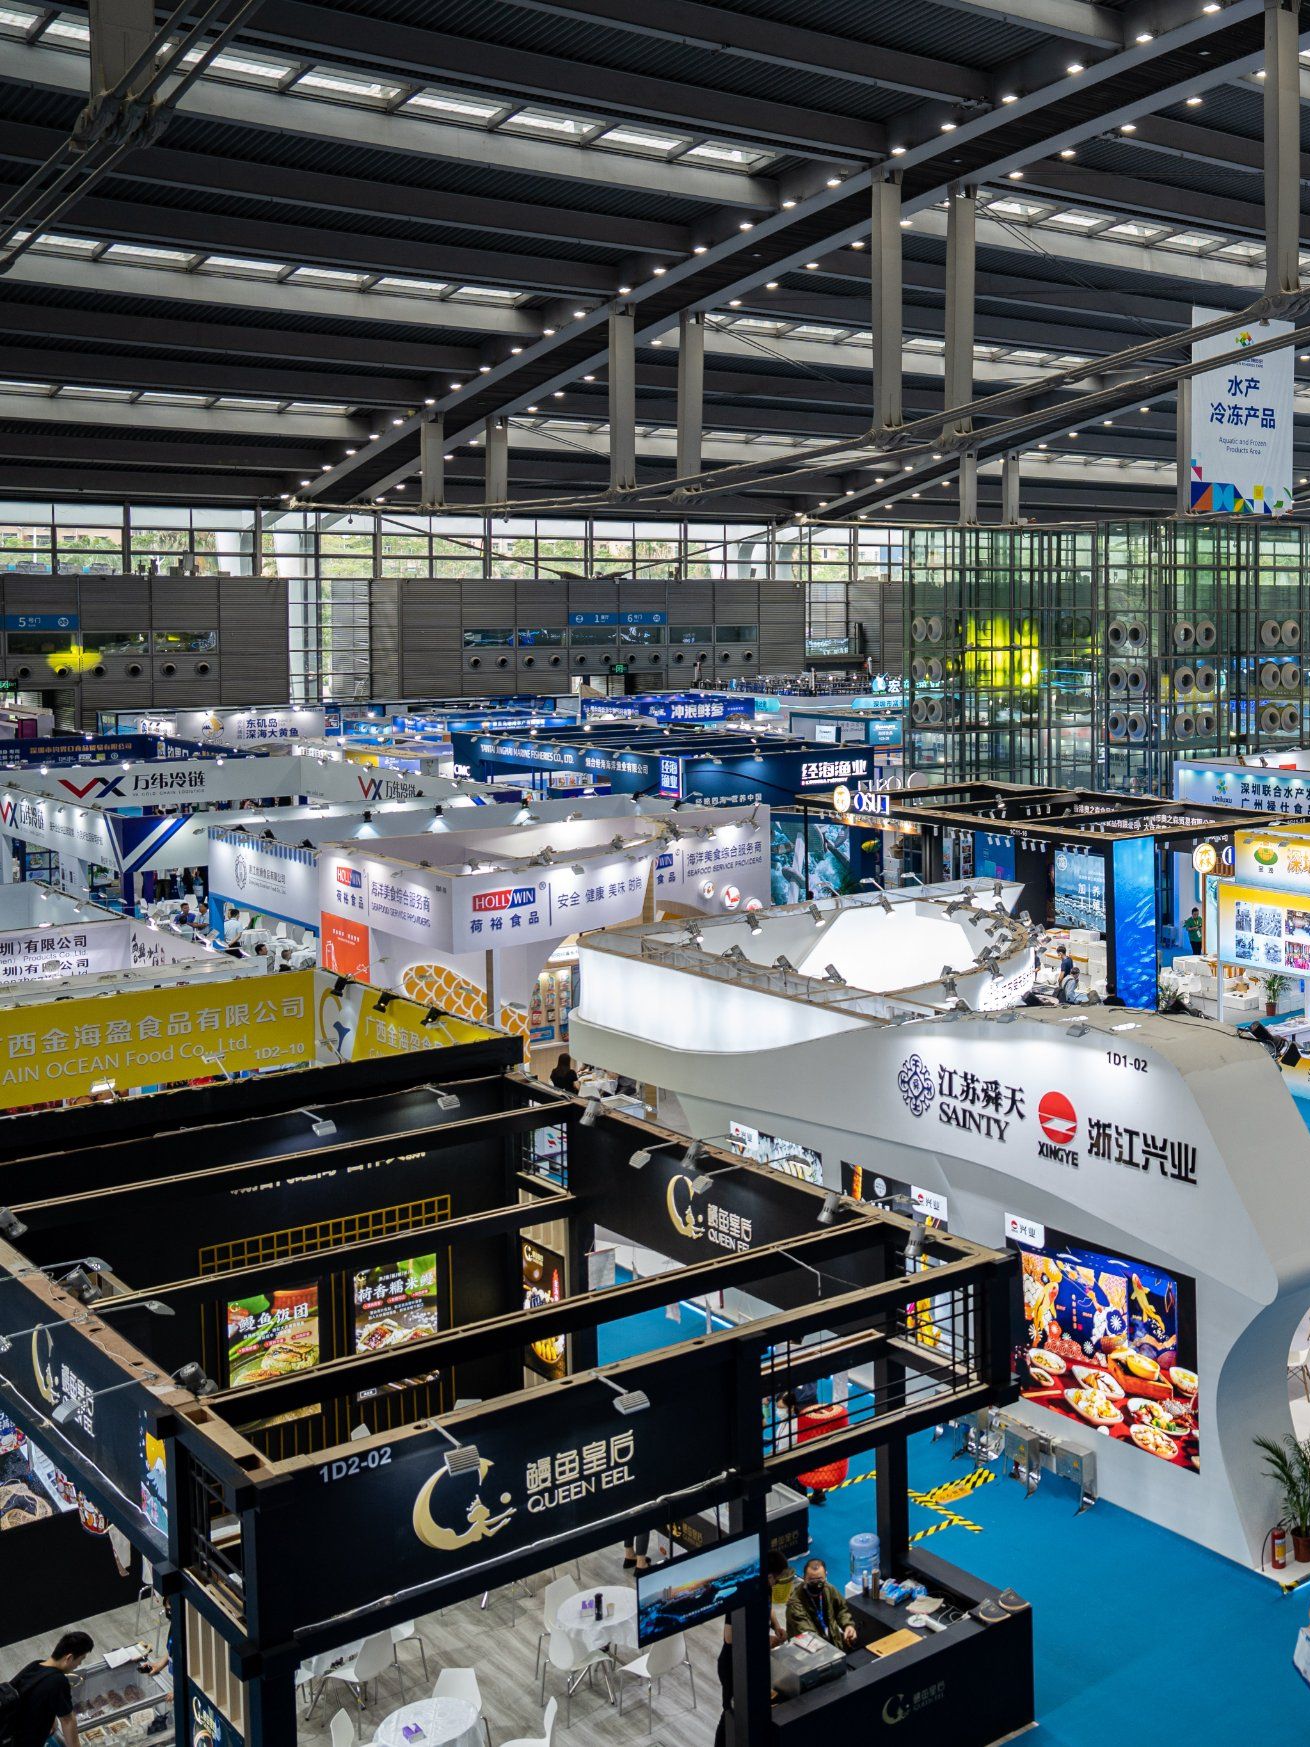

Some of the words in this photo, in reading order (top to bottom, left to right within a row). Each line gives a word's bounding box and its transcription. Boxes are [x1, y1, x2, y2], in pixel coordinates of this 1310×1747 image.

[1227, 375, 1260, 397] 水产
[1210, 402, 1276, 429] 冷冻产品
[1219, 436, 1239, 445] Aquatic
[1250, 439, 1267, 447] Frozen
[1226, 446, 1248, 455] Products
[19, 617, 26, 627] 5
[245, 728, 299, 740] 深海大黄鱼
[133, 771, 205, 791] 万纬冷链
[801, 759, 867, 780] 经海渔业
[686, 841, 762, 867] 海洋美食综合服务商
[371, 881, 431, 913] 海洋美食综合服务商
[475, 888, 535, 911] HOLLYWIN
[557, 892, 581, 909] 安全
[585, 884, 605, 902] 健康
[608, 879, 625, 896] 美味
[628, 875, 643, 892] 时尚
[470, 910, 540, 933] 荷裕食品
[3, 958, 89, 976] 圳)有公司
[23, 953, 57, 962] Products
[0, 996, 305, 1059] 西金海盈食品有限公司
[45, 1053, 119, 1079] OCEAN
[126, 1044, 175, 1067] Food
[180, 1042, 214, 1059] Co.,
[218, 1035, 252, 1053] Ltd.
[254, 1042, 305, 1061] 1D2-10
[1106, 1051, 1149, 1074] 1D1-02
[938, 1063, 1026, 1121] 江苏舜天
[938, 1100, 1011, 1143] SAINTY
[1037, 1140, 1079, 1168] XINGYE
[1087, 1116, 1198, 1186] 浙江兴业
[707, 1203, 753, 1242] 鳗鱼皇后
[1018, 1223, 1038, 1239] 兴业
[707, 1229, 736, 1253] QUEEN
[357, 1271, 435, 1302] 荷香糯米鳗
[238, 1301, 309, 1332] 鳗鱼饭团
[319, 1446, 392, 1484] 1D2-02
[526, 1429, 635, 1495] 鳗鱼皇后
[526, 1477, 596, 1514] QUEEN
[601, 1465, 635, 1489] EEL
